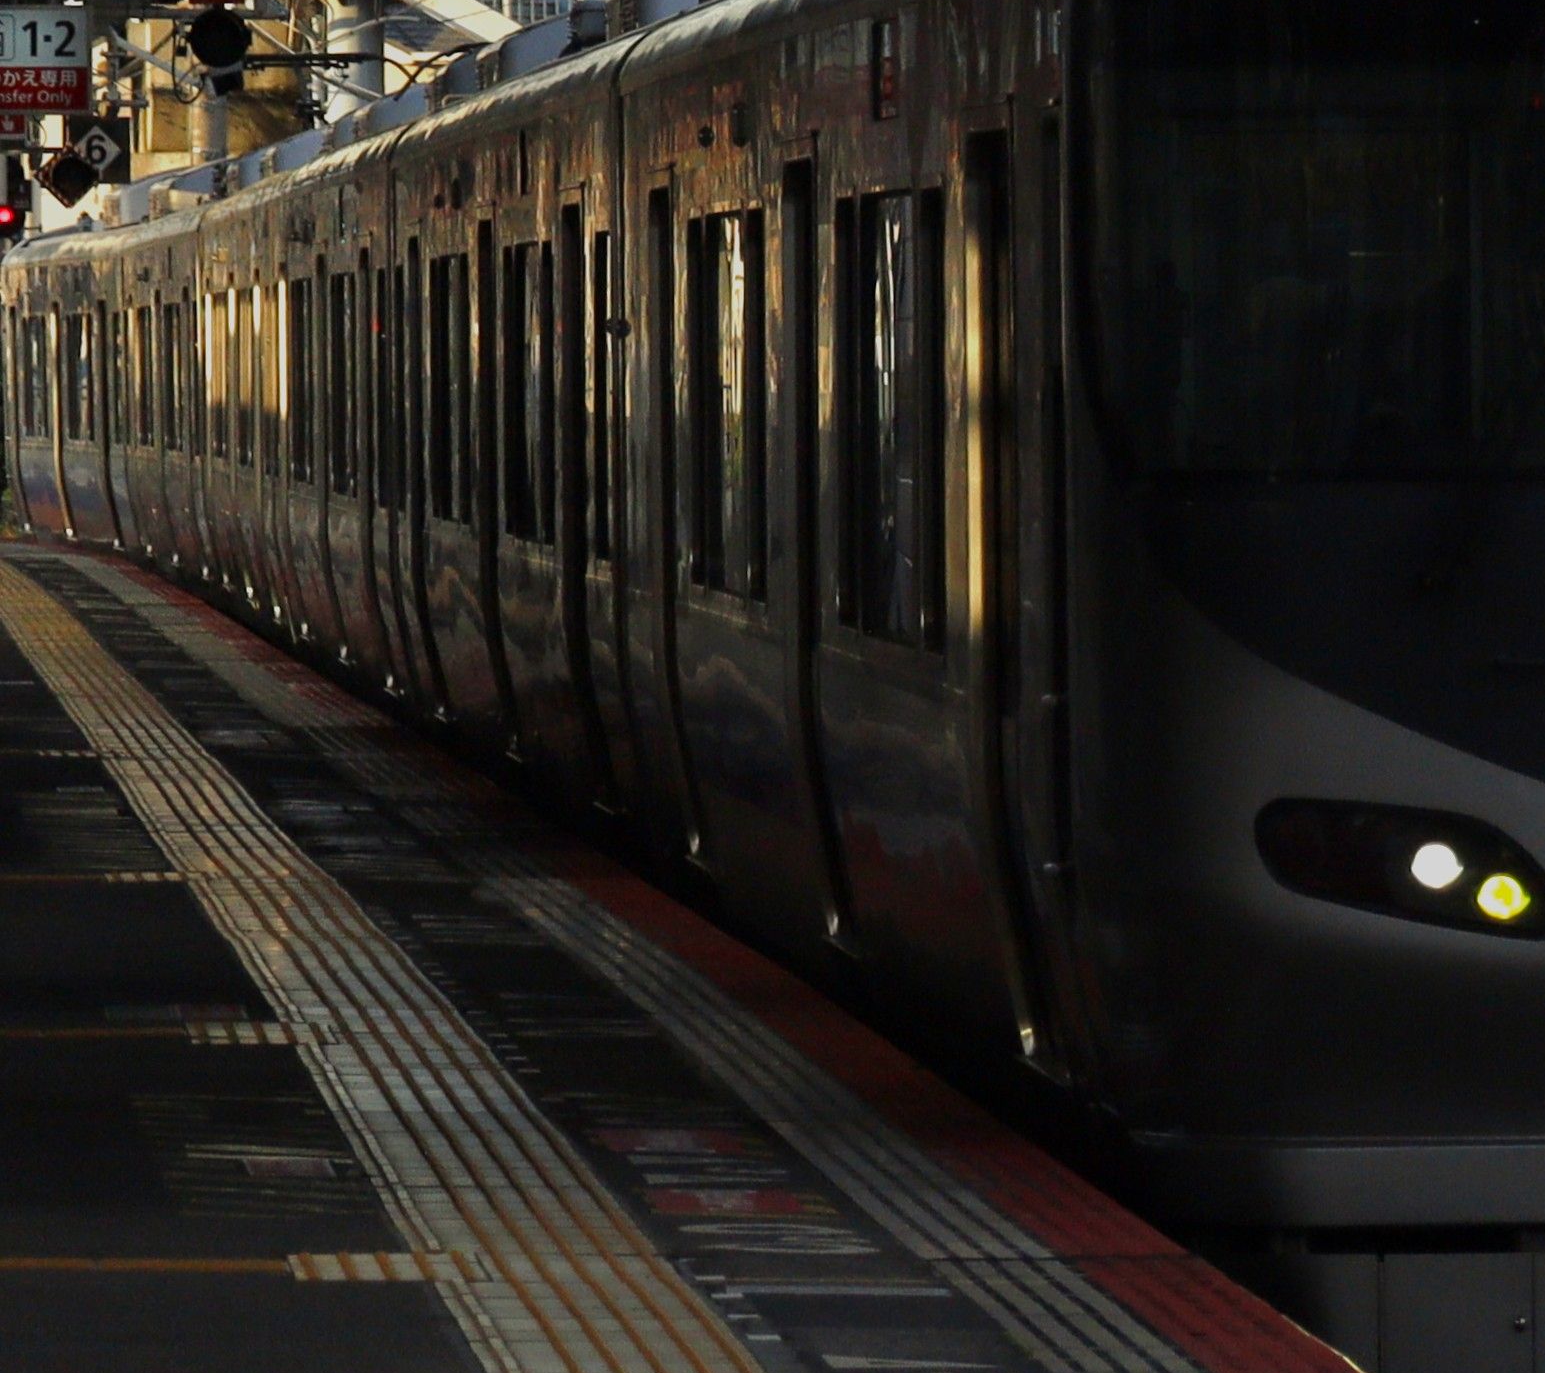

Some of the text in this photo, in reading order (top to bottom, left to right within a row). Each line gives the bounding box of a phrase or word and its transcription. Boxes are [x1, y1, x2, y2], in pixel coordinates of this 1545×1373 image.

[0, 70, 78, 88] かえ専用
[37, 89, 73, 106] Only
[85, 134, 106, 165] 6
